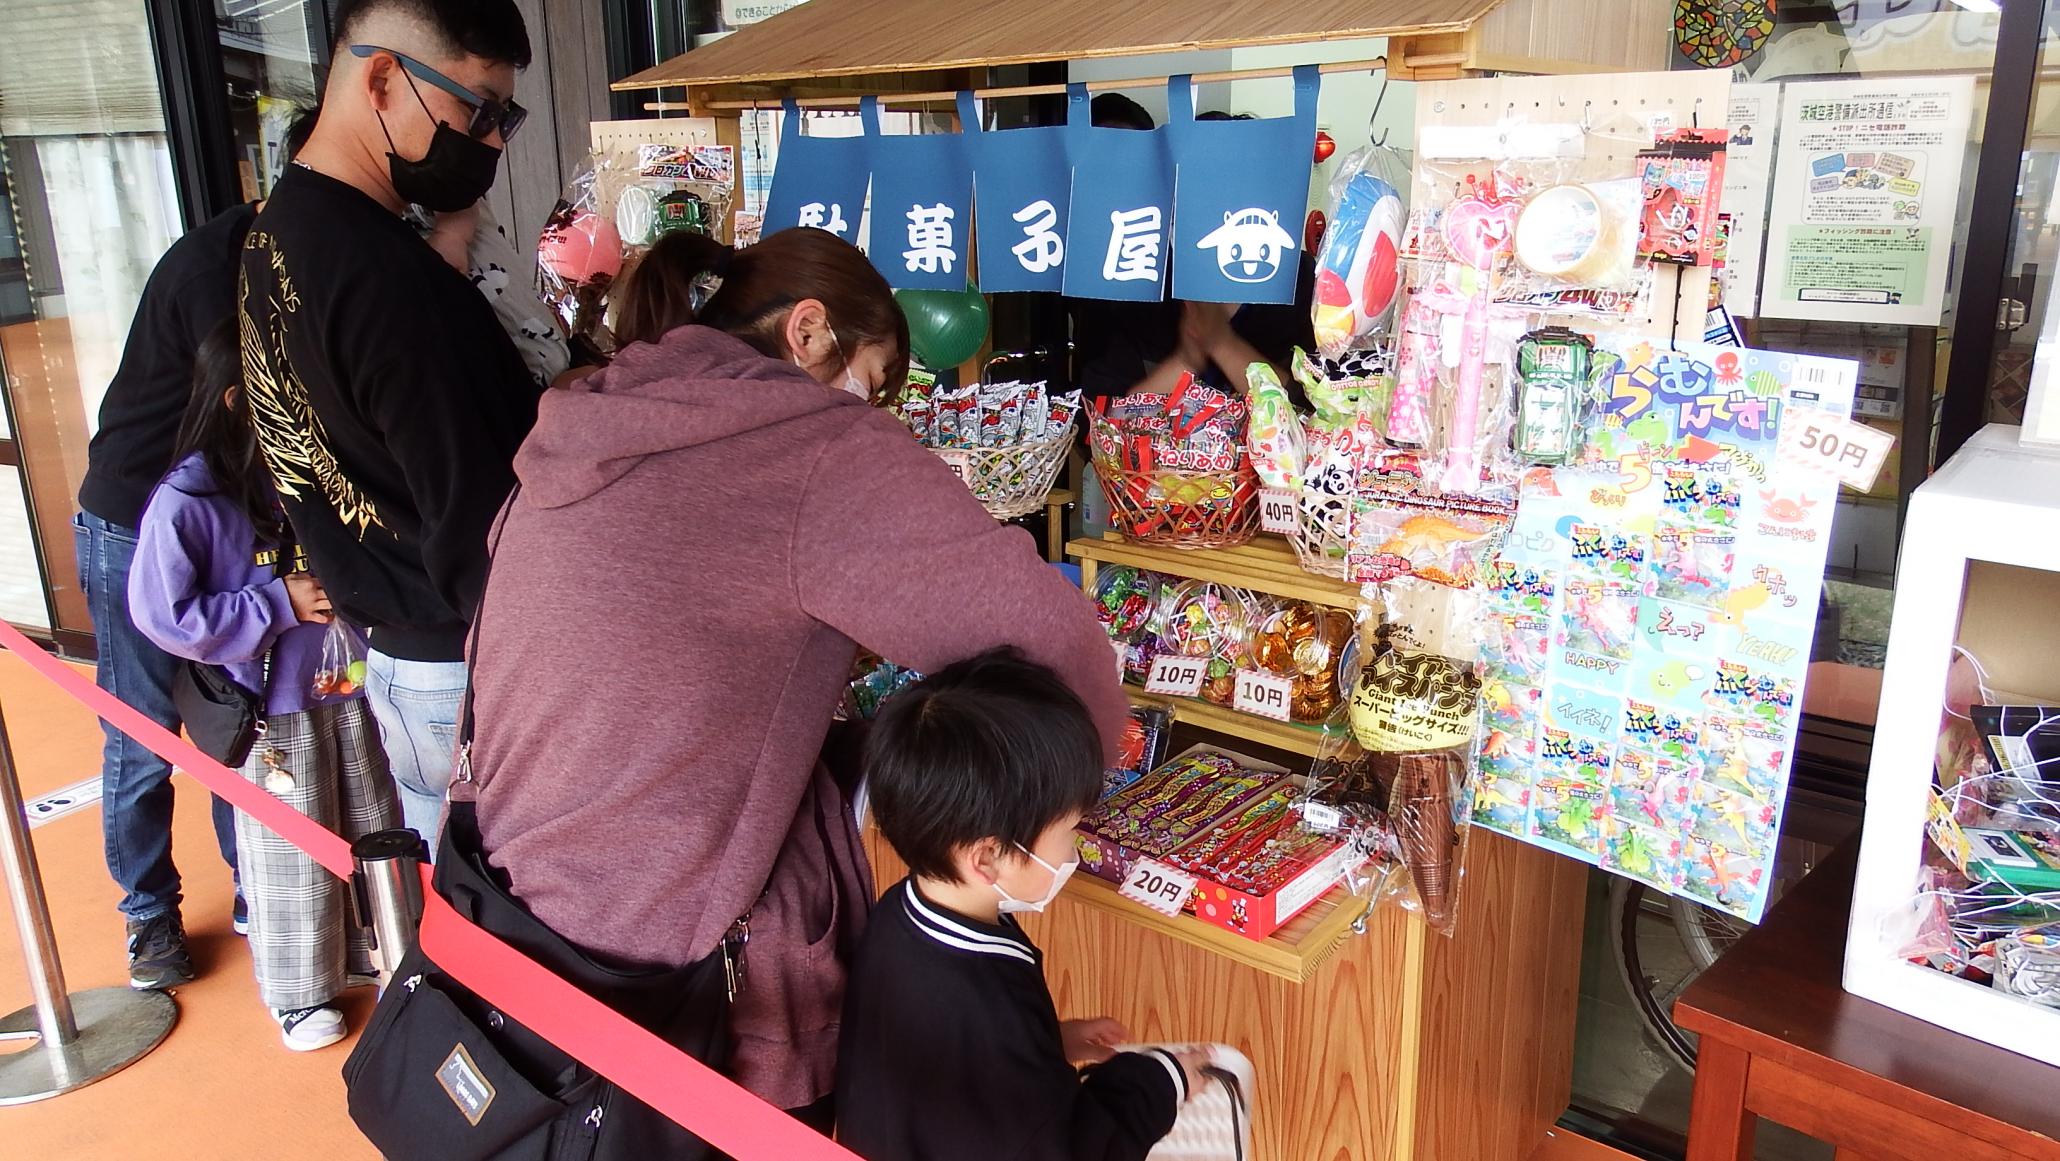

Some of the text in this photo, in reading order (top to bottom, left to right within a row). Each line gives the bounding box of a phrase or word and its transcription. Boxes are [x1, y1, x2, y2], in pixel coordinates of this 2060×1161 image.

[1799, 425, 1868, 468] 50円
[1159, 447, 1235, 471] ねりあめ
[1265, 502, 1294, 524] 40円
[1403, 494, 1445, 508] DINOSAUR
[1445, 501, 1481, 513] PICTURE
[1481, 504, 1506, 515] BOOK
[1156, 665, 1197, 685] 10円
[1565, 651, 1620, 676] HAPPY
[1242, 682, 1283, 708] 10円
[1368, 688, 1396, 706] Giant
[1557, 702, 1613, 734] イイネ!
[1132, 868, 1182, 902] 20円
